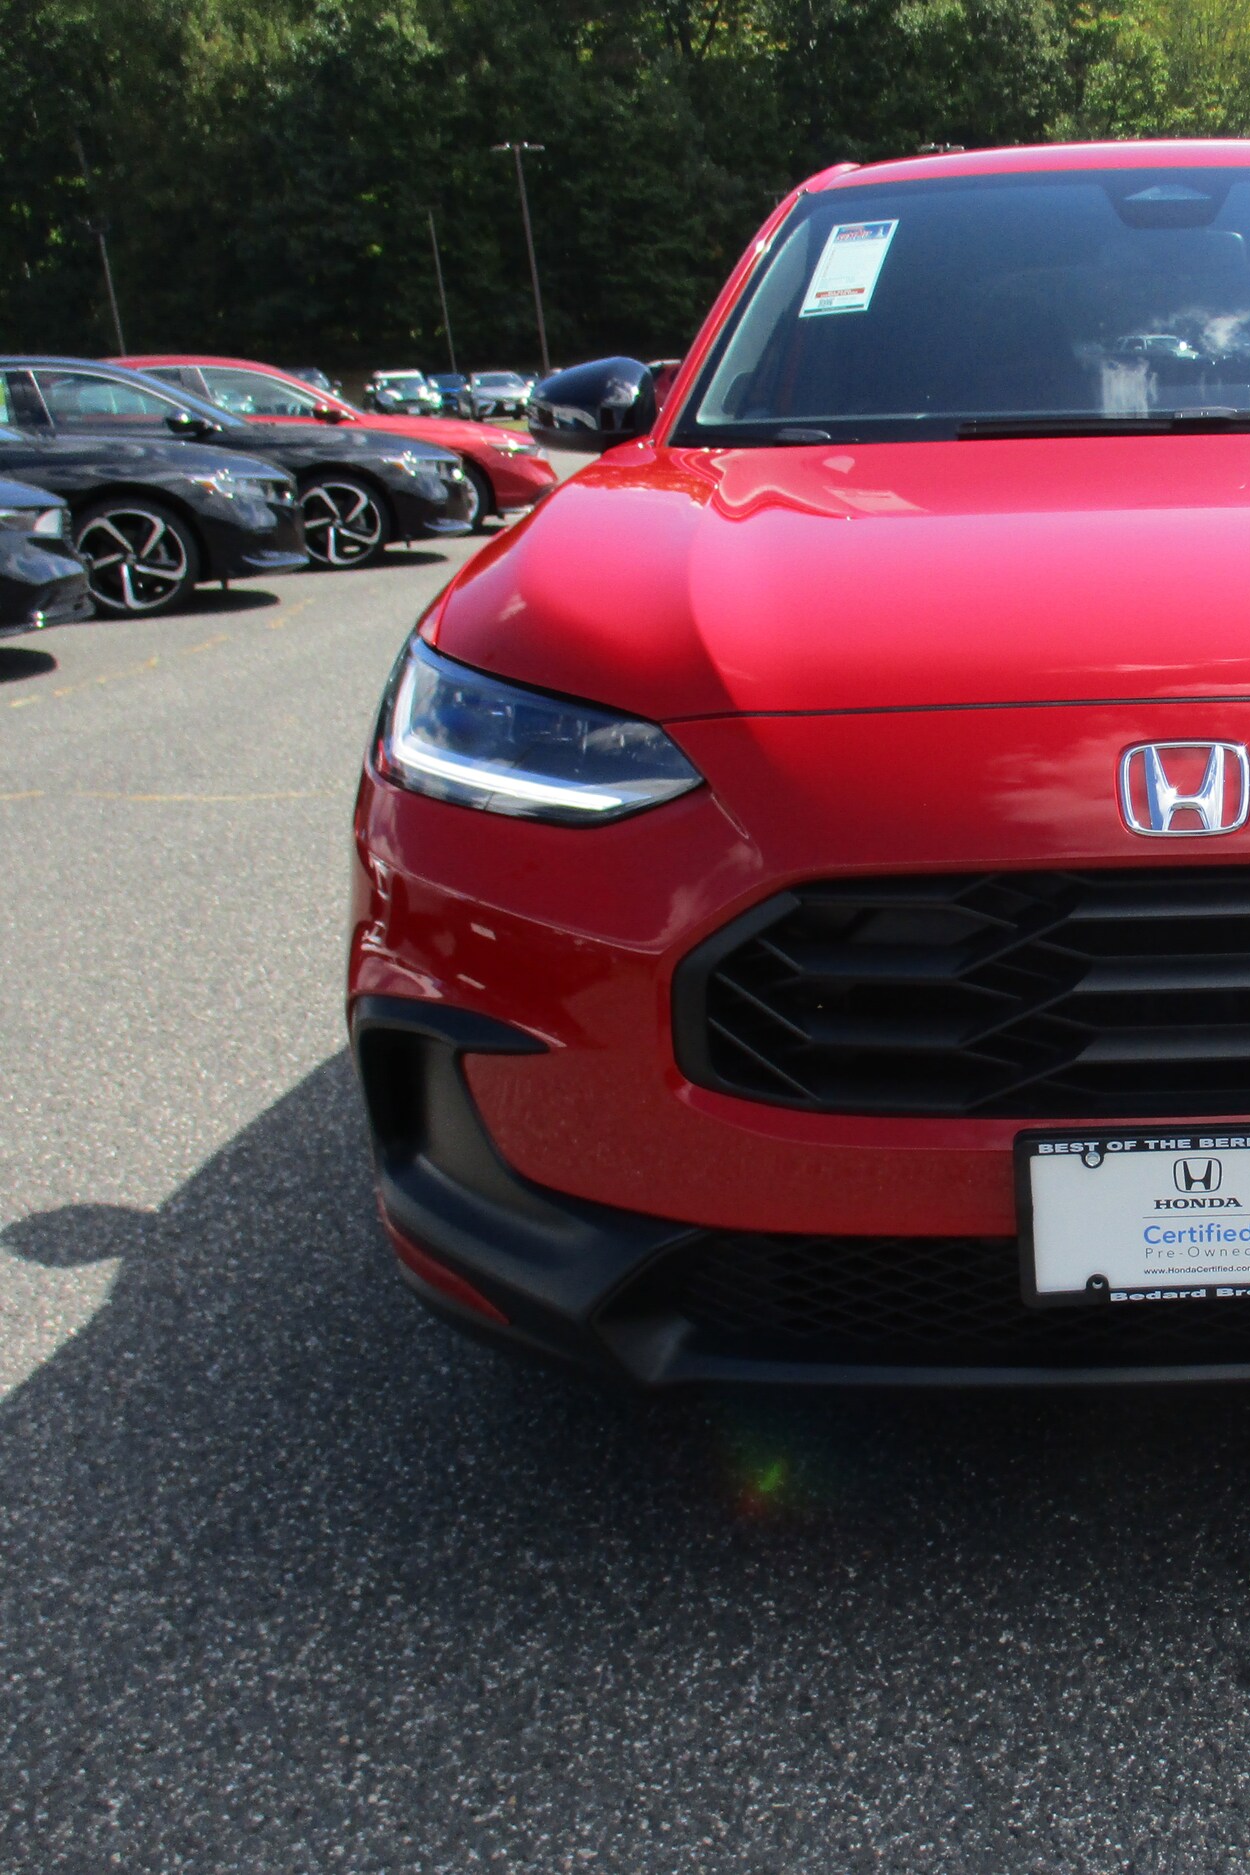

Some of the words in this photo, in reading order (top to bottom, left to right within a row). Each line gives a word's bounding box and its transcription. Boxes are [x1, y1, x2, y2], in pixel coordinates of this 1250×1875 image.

[1038, 1141, 1099, 1154] BEST
[1106, 1140, 1137, 1151] OF
[1144, 1139, 1192, 1150] THE
[1154, 1197, 1243, 1210] HONDA
[1109, 1288, 1207, 1302] Bedard
